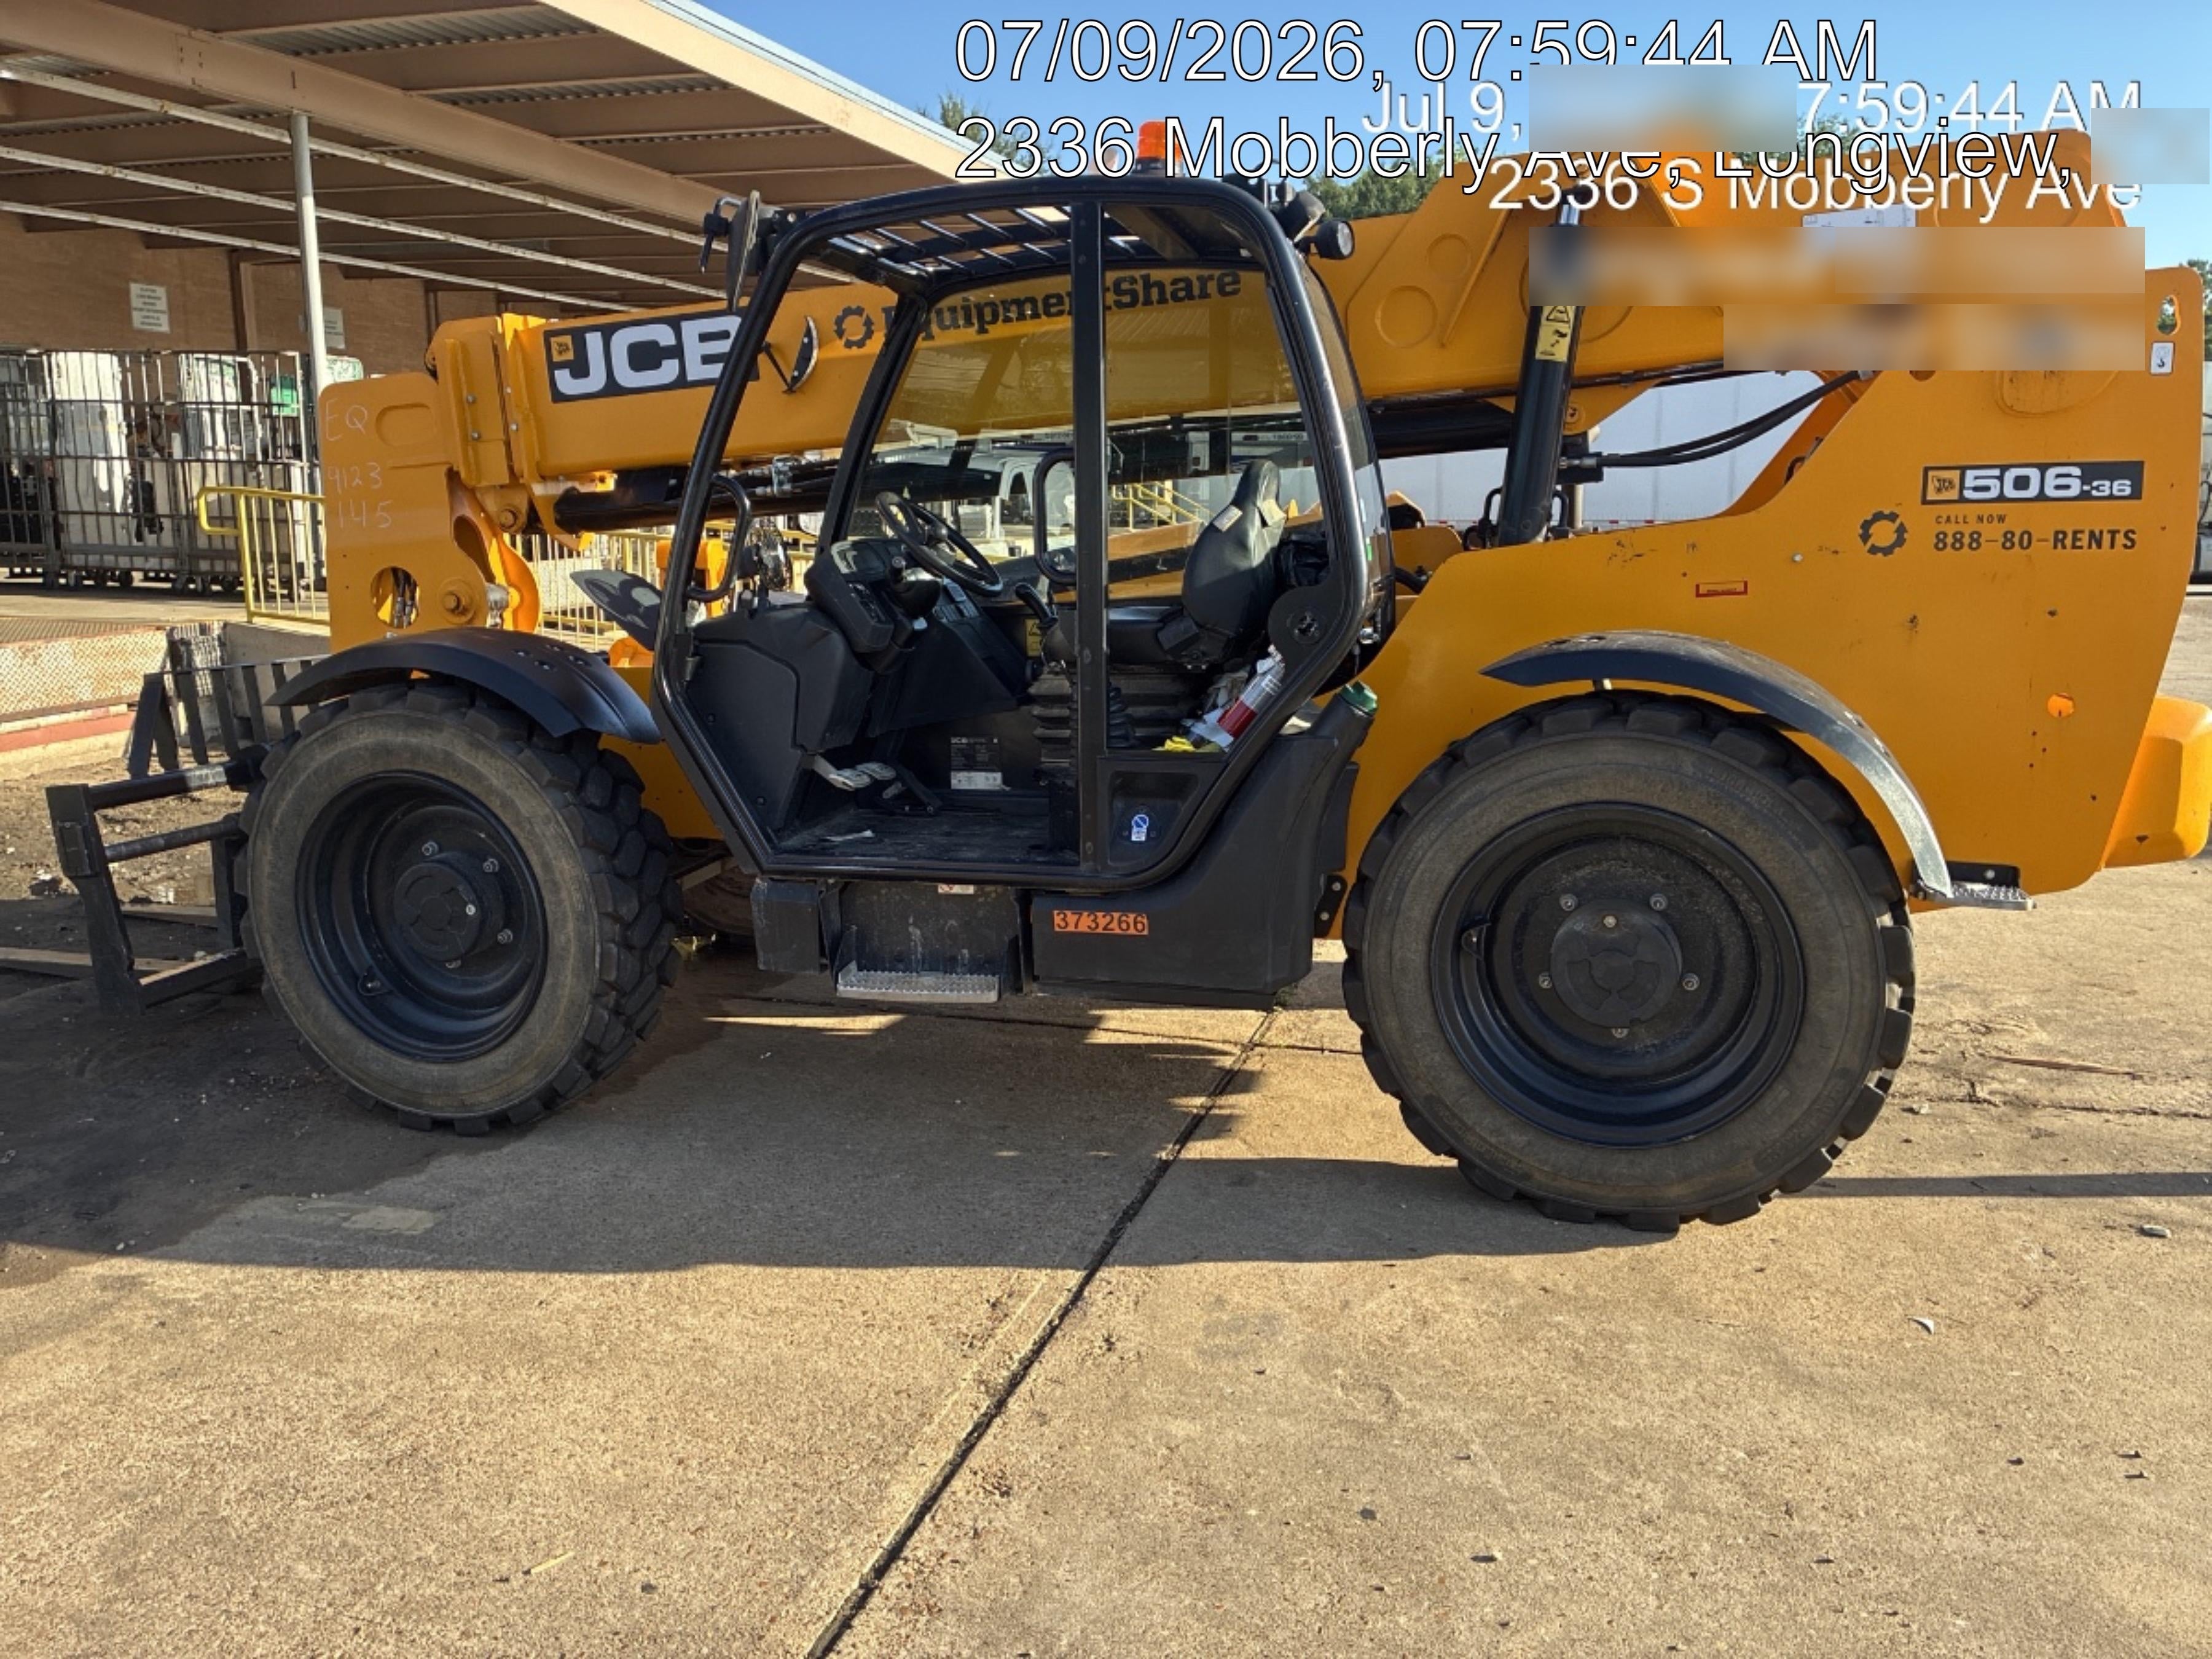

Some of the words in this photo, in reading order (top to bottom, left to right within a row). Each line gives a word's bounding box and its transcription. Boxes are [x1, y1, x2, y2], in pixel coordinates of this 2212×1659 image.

[554, 315, 742, 395] JCB
[326, 398, 368, 442] EQ
[1963, 466, 2132, 500] 506-36
[1936, 514, 1969, 524] CALL
[1975, 514, 2007, 524] NOW
[1934, 528, 2138, 551] 888-80-RENTS
[1055, 911, 1146, 933] 373266
